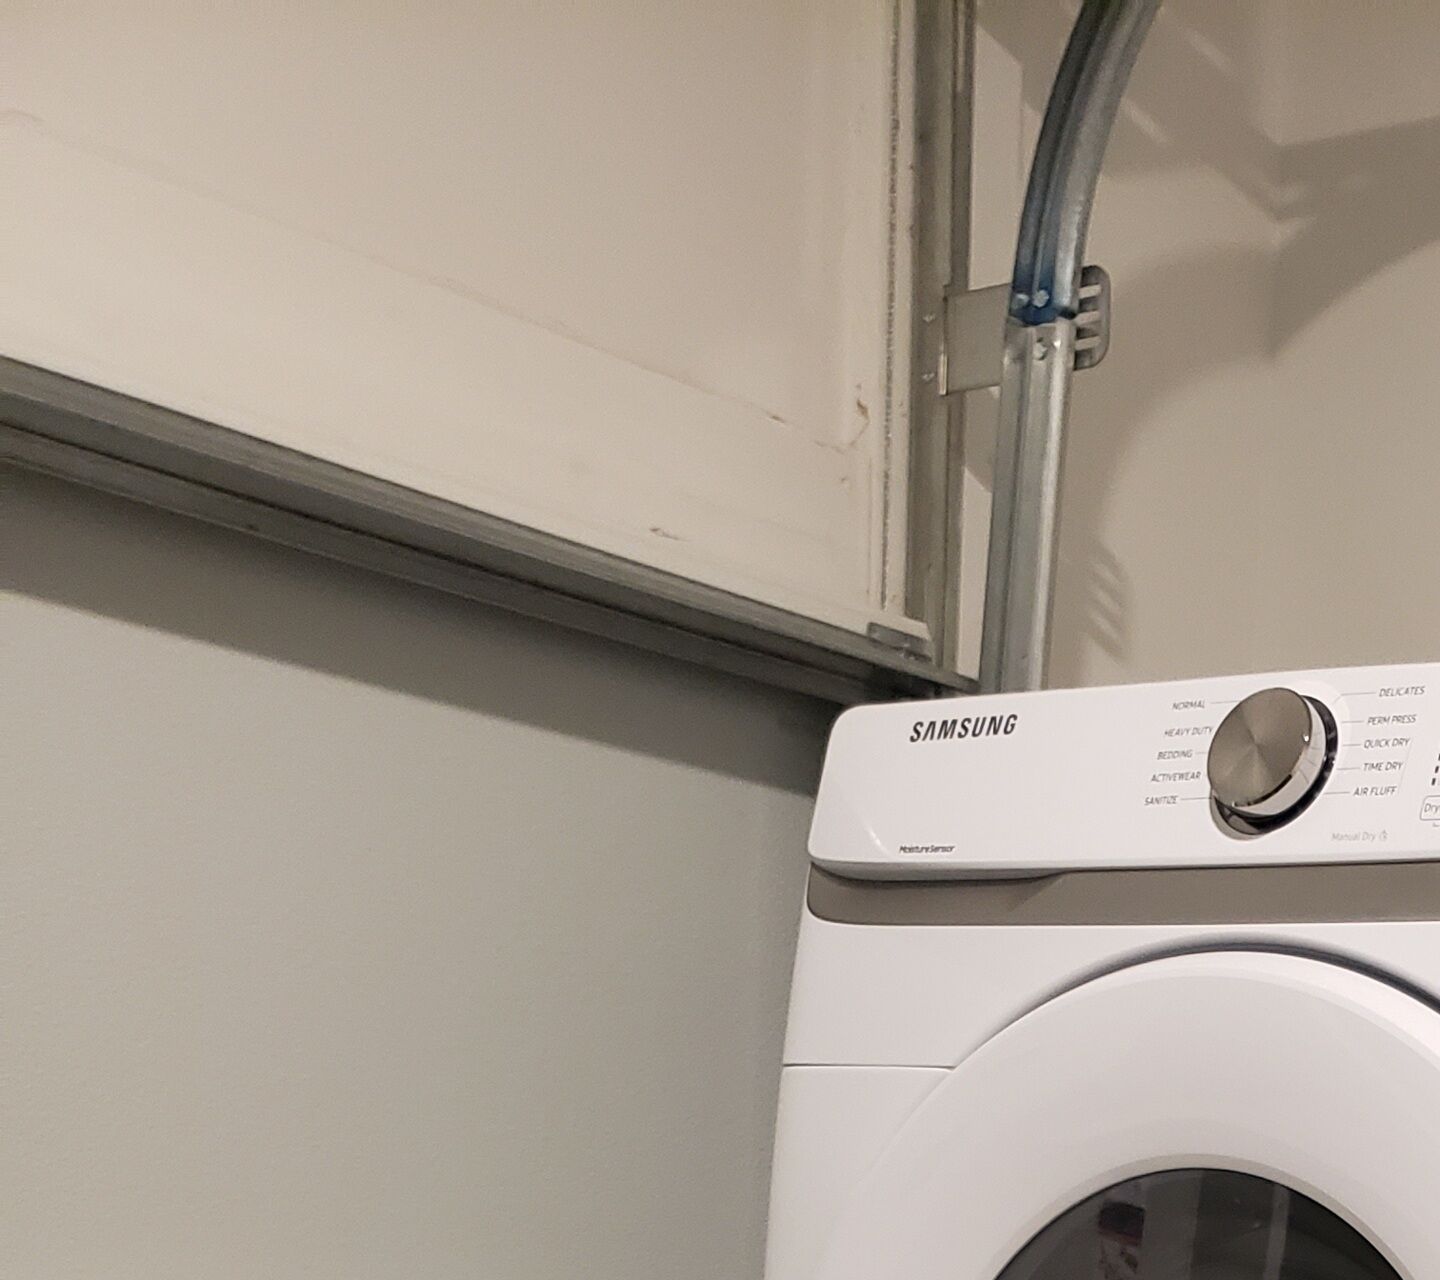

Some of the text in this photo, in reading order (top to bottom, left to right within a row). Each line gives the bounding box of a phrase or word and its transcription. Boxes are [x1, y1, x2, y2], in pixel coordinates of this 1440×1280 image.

[1378, 686, 1426, 698] DELICATES
[1172, 700, 1206, 711] NORMAL
[1367, 714, 1417, 726] PERM PRESS
[909, 714, 1018, 742] SAMSUNG
[1164, 726, 1213, 738] HEAVY DUTY
[1363, 737, 1410, 749] QUICK DRY
[1157, 749, 1193, 760] BEDDING
[1363, 761, 1404, 772] TIME DRY
[1150, 771, 1202, 782] ACTIVEWEAR
[1353, 786, 1398, 796] AIR FLUFF
[1144, 795, 1178, 806] SANITIZE
[1331, 831, 1377, 843] Manual Dry
